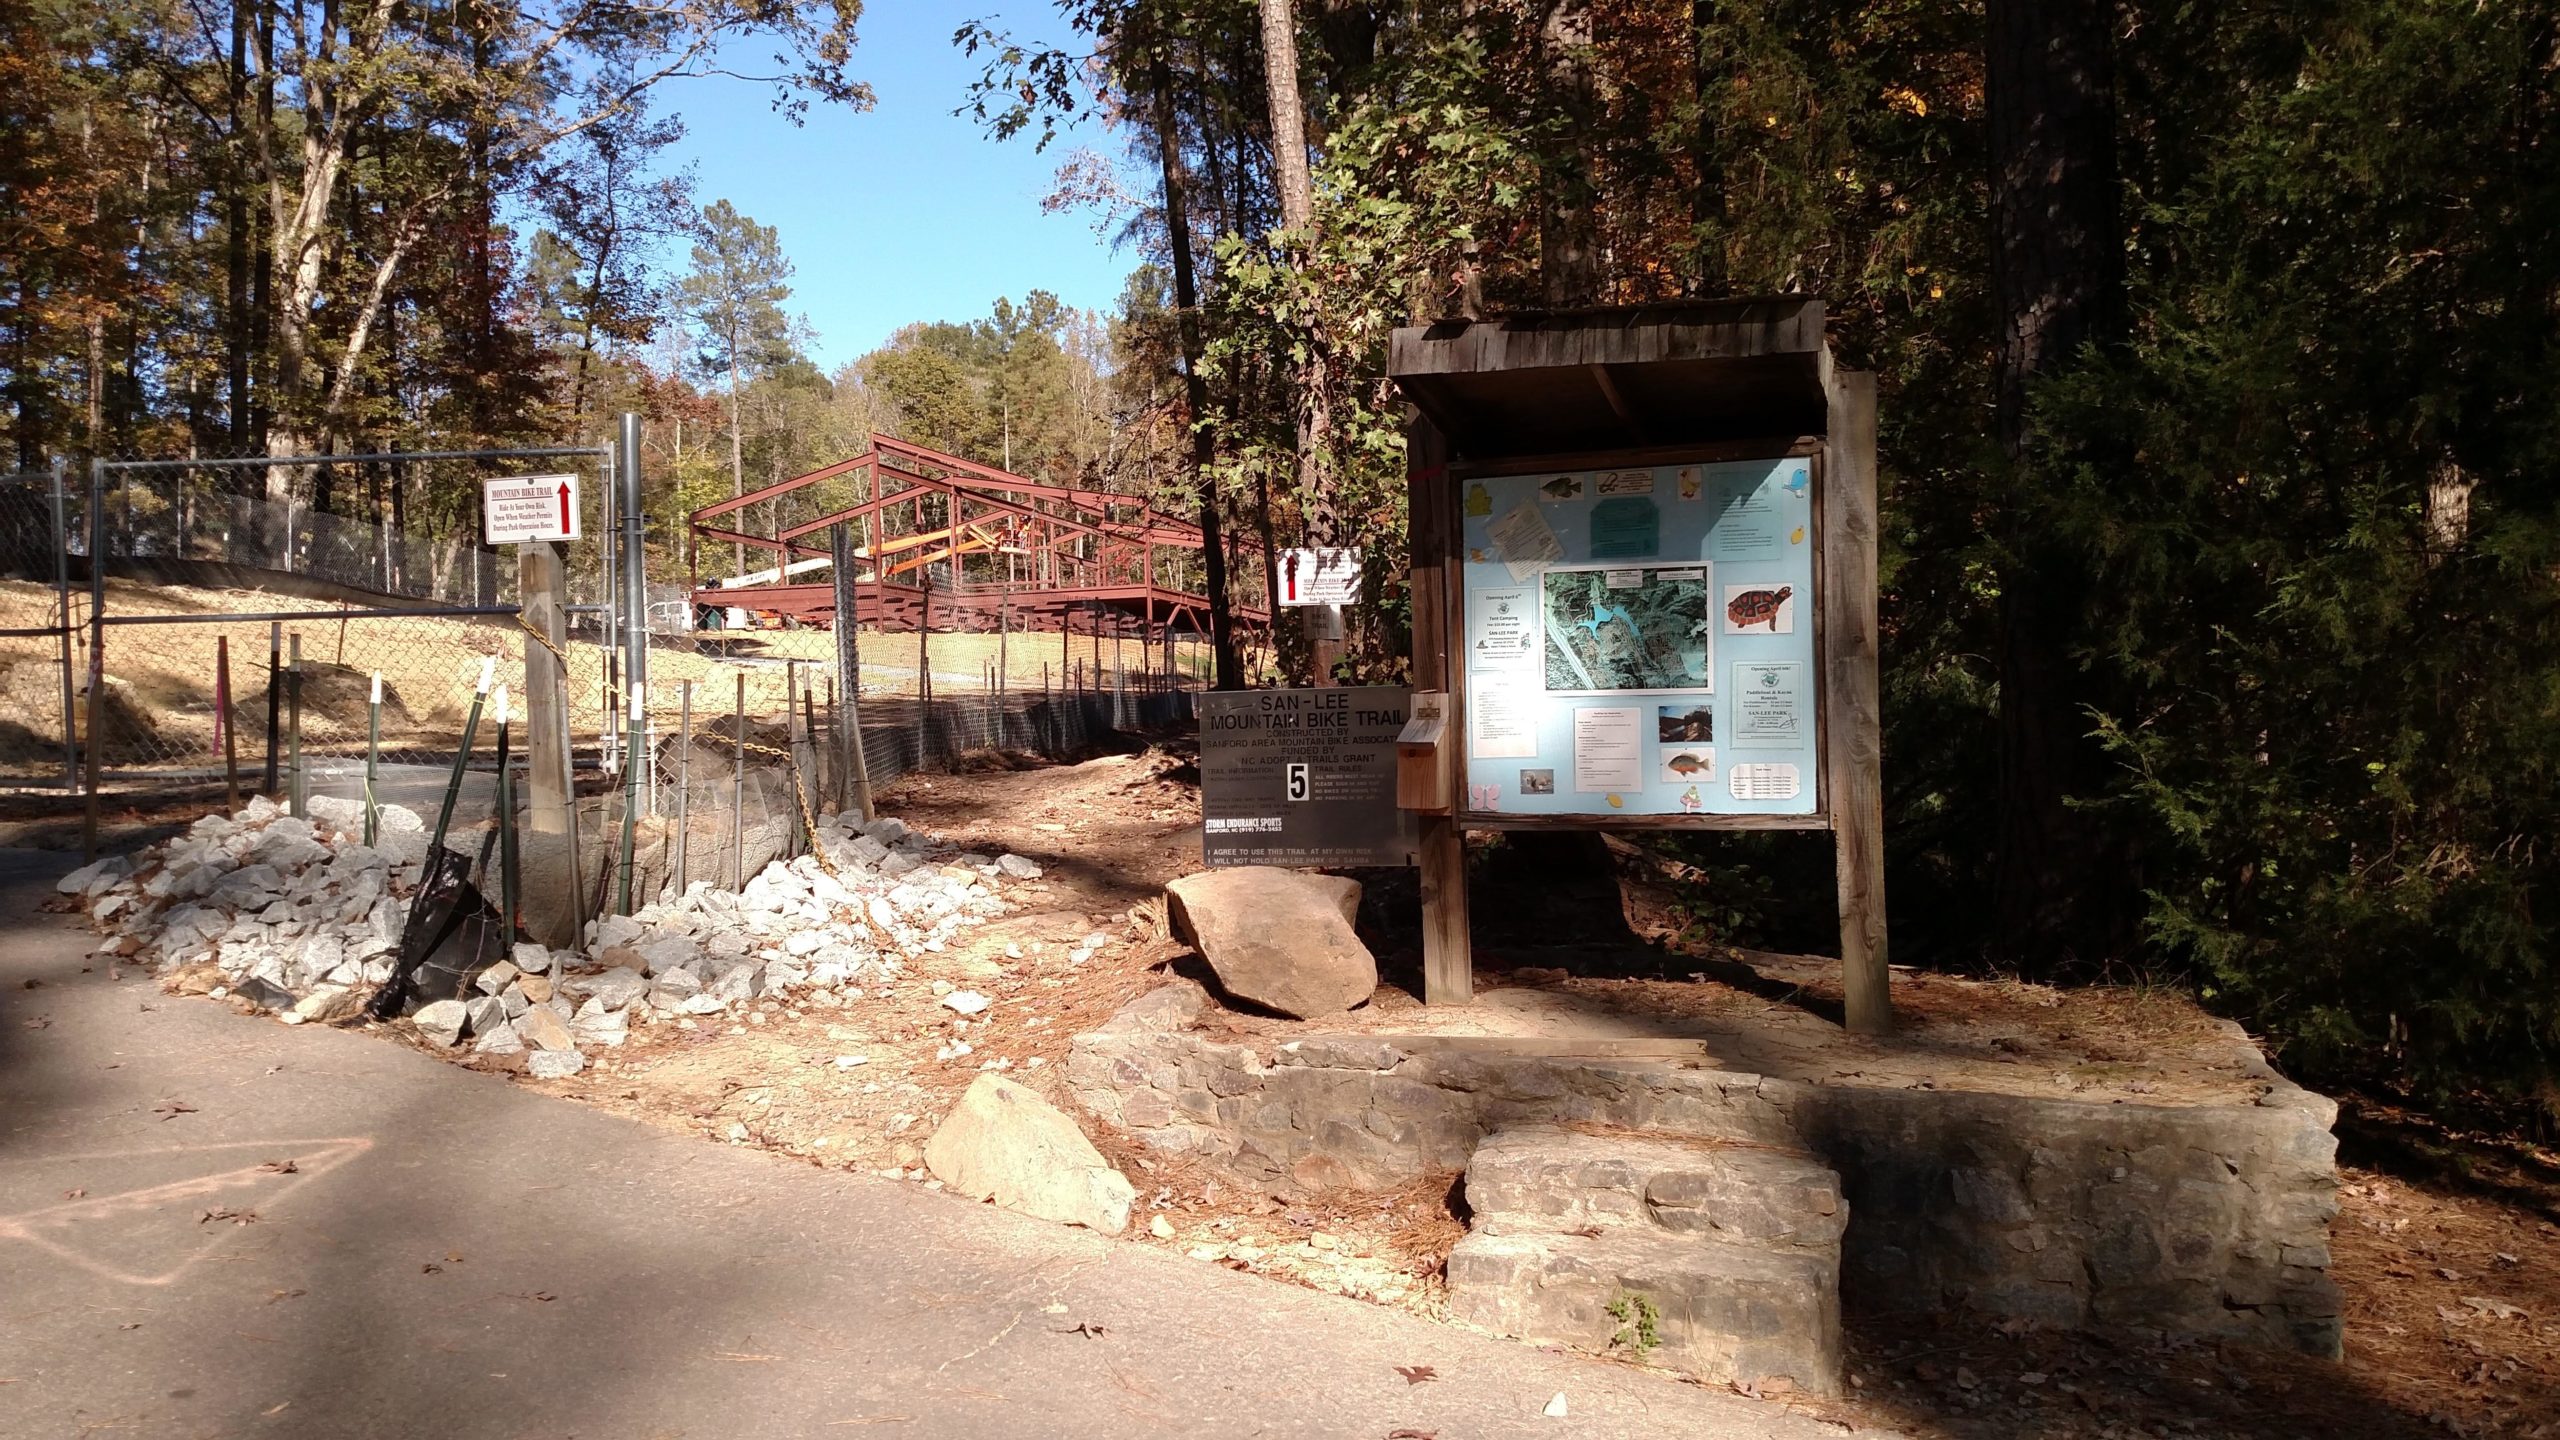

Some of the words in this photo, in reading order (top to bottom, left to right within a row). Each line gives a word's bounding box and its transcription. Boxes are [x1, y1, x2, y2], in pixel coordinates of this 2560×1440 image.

[492, 489, 520, 498] MOUNTAIN
[521, 488, 535, 496] BIKE
[536, 487, 553, 495] TRAIL
[494, 514, 505, 522] Open
[494, 524, 508, 532] During
[1210, 713, 1300, 730] MOUNTAIN
[1307, 711, 1348, 728] BIKE
[1355, 710, 1404, 726] TRAIL
[1265, 728, 1333, 738] CONSTRUCTED
[1337, 728, 1349, 736] BY
[1206, 740, 1248, 748] SANFORD
[1252, 739, 1276, 747] AREA
[1279, 738, 1325, 747] MOUNTAIN
[1328, 737, 1350, 745] BIKE
[1281, 746, 1319, 755] FUNDED
[1323, 746, 1335, 754] BY
[1241, 757, 1256, 765] NC
[1260, 756, 1290, 764] ADOPT
[1306, 755, 1339, 764] TRAILS
[1343, 754, 1376, 763] GRANT
[1291, 766, 1306, 799] 5
[1205, 818, 1226, 829] STORM
[1227, 818, 1259, 828] ENDURANCE
[1260, 817, 1282, 827] SPORTS
[1213, 848, 1237, 856] AGREE
